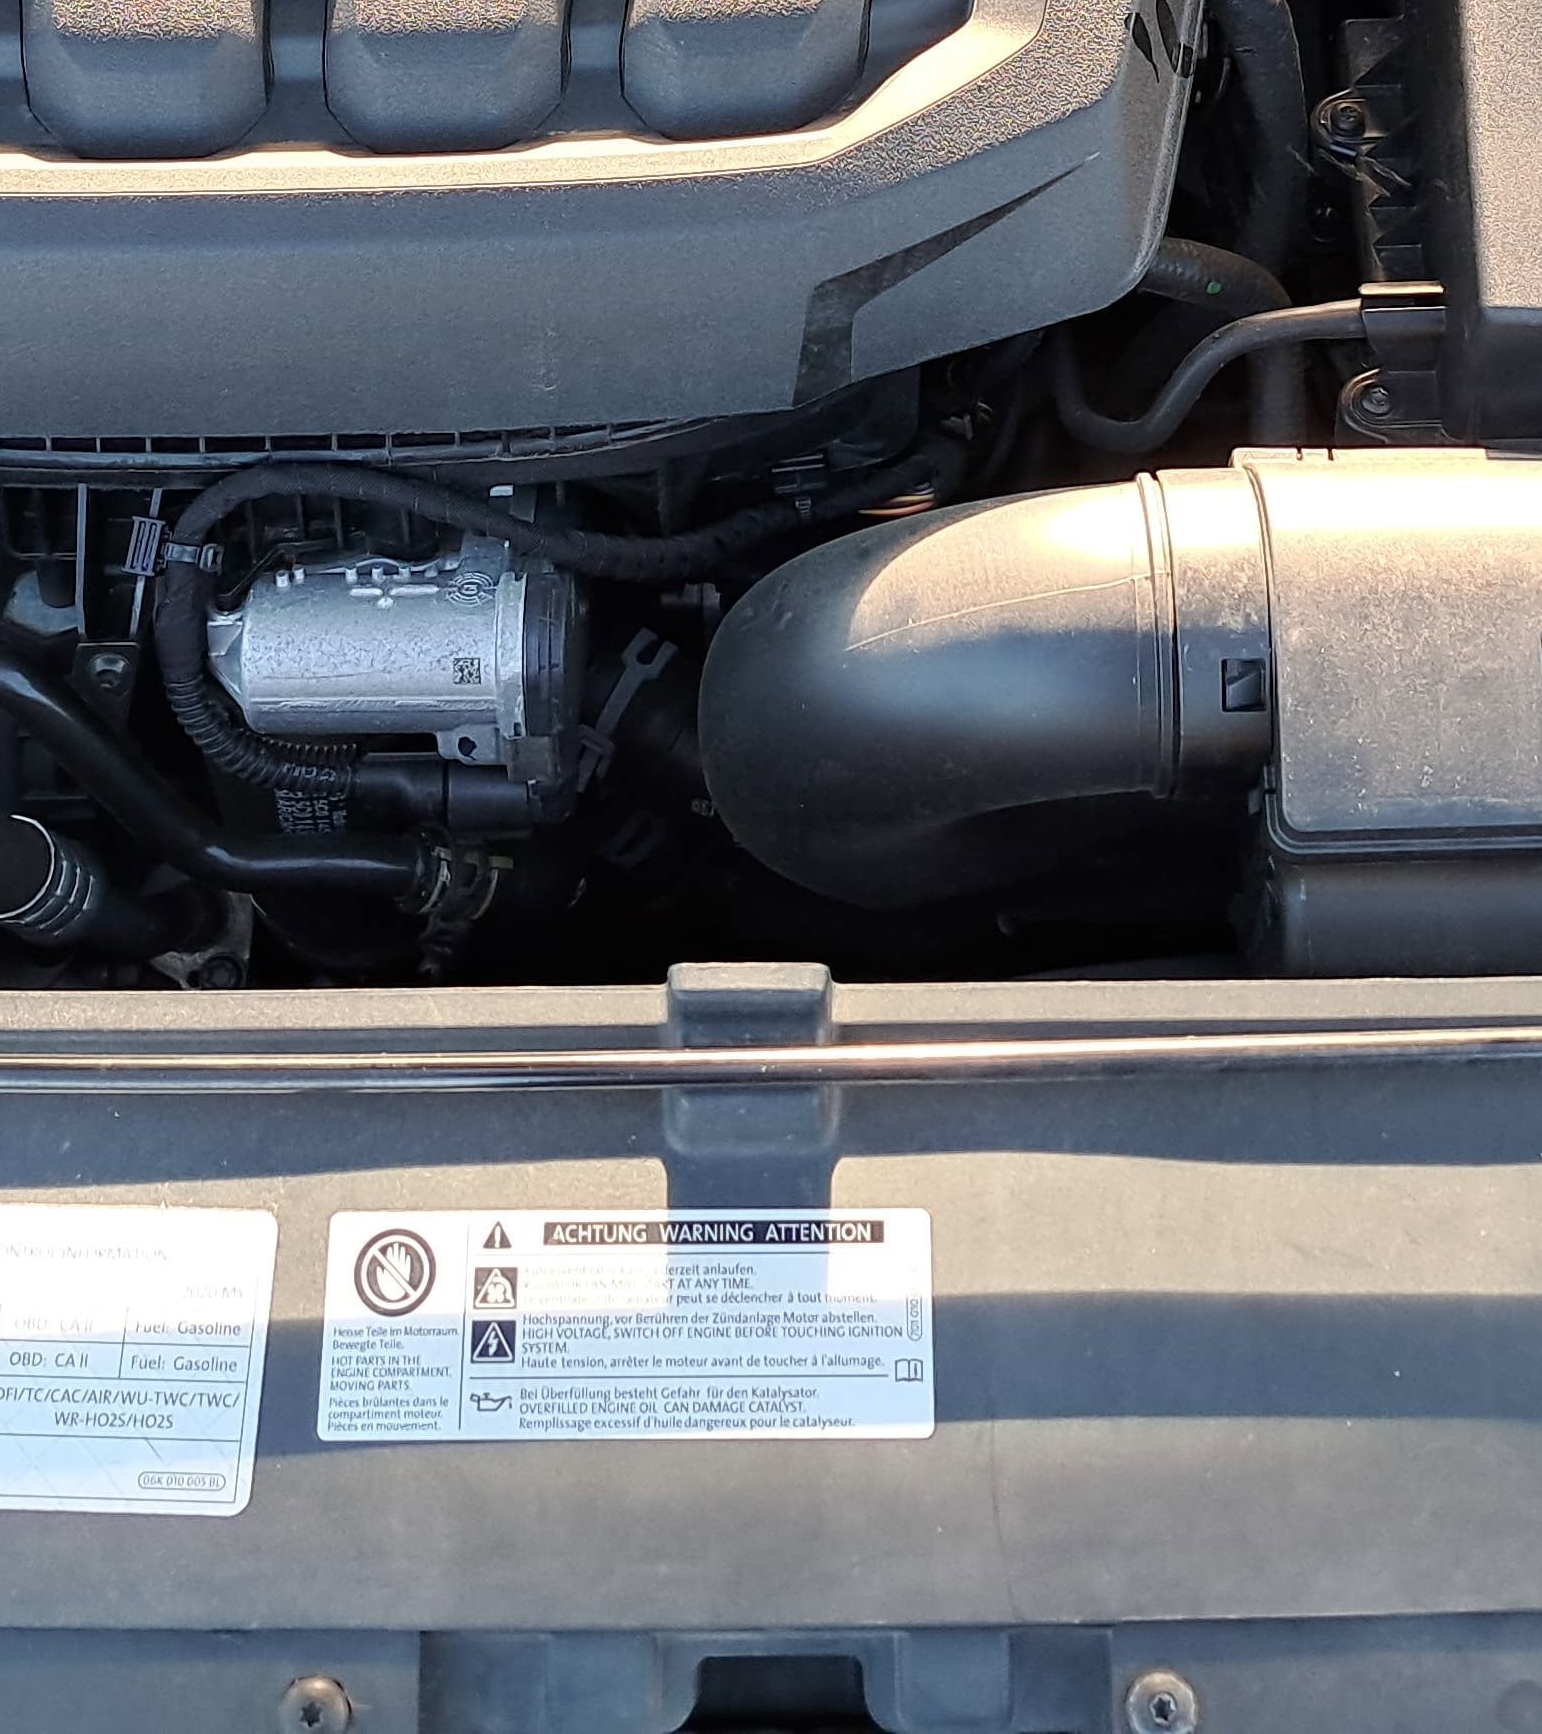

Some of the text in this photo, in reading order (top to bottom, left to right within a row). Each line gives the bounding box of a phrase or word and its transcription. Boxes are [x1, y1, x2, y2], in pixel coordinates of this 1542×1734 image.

[552, 1223, 871, 1243] ACHTUNG WARNING ATTENTION
[703, 1263, 757, 1276] anlaufen.
[677, 1279, 691, 1289] AT
[694, 1278, 722, 1289] ANY
[676, 1292, 702, 1306] peut
[705, 1295, 719, 1303] se
[787, 1292, 794, 1303] à
[797, 1291, 822, 1303] tout
[523, 1311, 877, 1328] Hochspannung, vor Berühren der Zündanlage Motor abstellen.
[177, 1320, 242, 1336] Gasoline
[522, 1325, 903, 1340] HIGH VOLTAGE, SWITCH OFF ENGINE BEFORE TOUCHING IGNITION
[9, 1351, 47, 1368] OBD:
[54, 1352, 76, 1368] CA
[79, 1353, 88, 1368] II
[131, 1354, 166, 1370] Fuel:
[173, 1356, 237, 1373] Gasoline
[332, 1355, 421, 1365] HOT PARTS IN THE
[522, 1354, 885, 1370] Haute tension, arrêter le moteur avant de toucher à l'allumage.
[331, 1367, 369, 1377] ENGINE
[330, 1380, 374, 1391] MOVING
[614, 1386, 657, 1399] besteht
[661, 1386, 700, 1399] Gefahr
[707, 1386, 723, 1399] für
[727, 1386, 748, 1398] den
[751, 1386, 819, 1401] Katalysator.
[519, 1401, 806, 1415] OVERFILLED ENGINE OIL CAN DAMAGE CATALYST.
[519, 1415, 855, 1432] Remplissage excessif d'huile dangereux pour le catalyseur.
